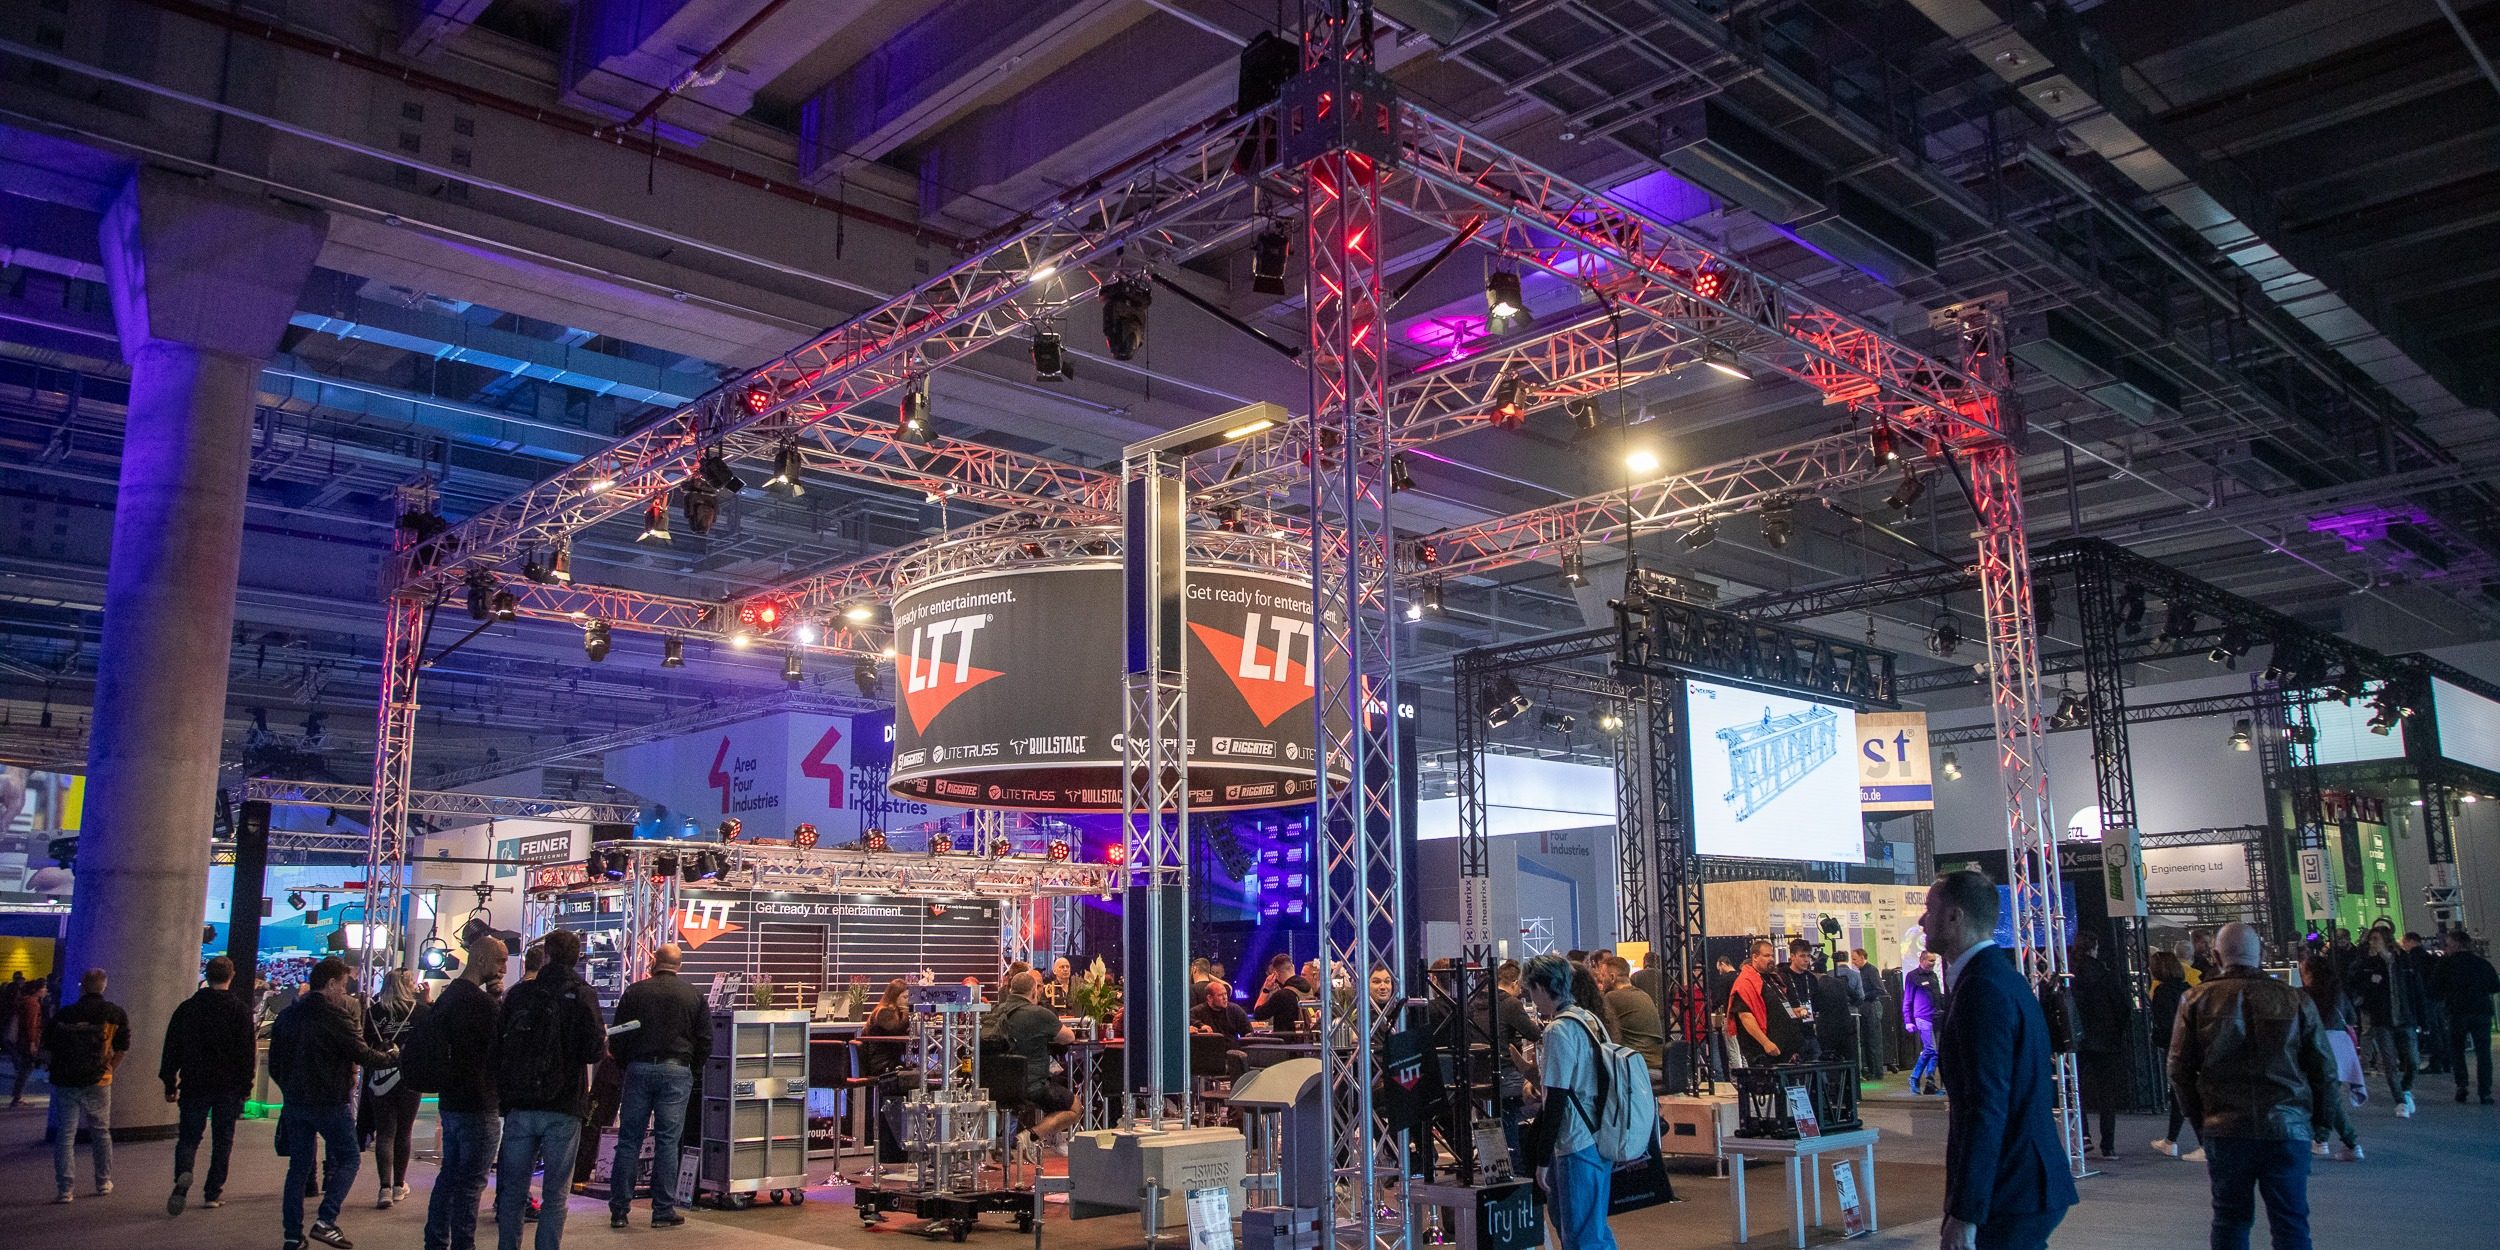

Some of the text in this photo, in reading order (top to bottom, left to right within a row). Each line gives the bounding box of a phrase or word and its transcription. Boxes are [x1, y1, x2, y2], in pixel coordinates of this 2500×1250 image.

[1186, 583, 1211, 600] Get
[1215, 587, 1252, 608] ready
[1255, 590, 1272, 606] for
[902, 606, 917, 626] ready
[918, 603, 929, 619] for
[930, 588, 1016, 616] entertainment.
[908, 614, 986, 694] LTT
[1029, 736, 1086, 755] BULLSTAGE
[734, 757, 757, 773] Area
[733, 777, 754, 792] Four
[732, 793, 779, 813] Industries
[849, 793, 928, 815] Industries
[1082, 788, 1123, 803] BULLSTAG
[521, 837, 568, 855] FEINER
[1551, 844, 1590, 856] Industries
[2151, 862, 2223, 875] Engineering Ltd
[2306, 858, 2317, 880] ELC
[1464, 879, 1472, 926] theatrixx
[1818, 889, 1831, 902] UND
[684, 899, 738, 929] LTT
[755, 902, 904, 917] Get ready for entertainment.
[1400, 1062, 1422, 1084] LTT
[1198, 1162, 1229, 1180] SWISS
[1484, 1193, 1535, 1243] Try it!
